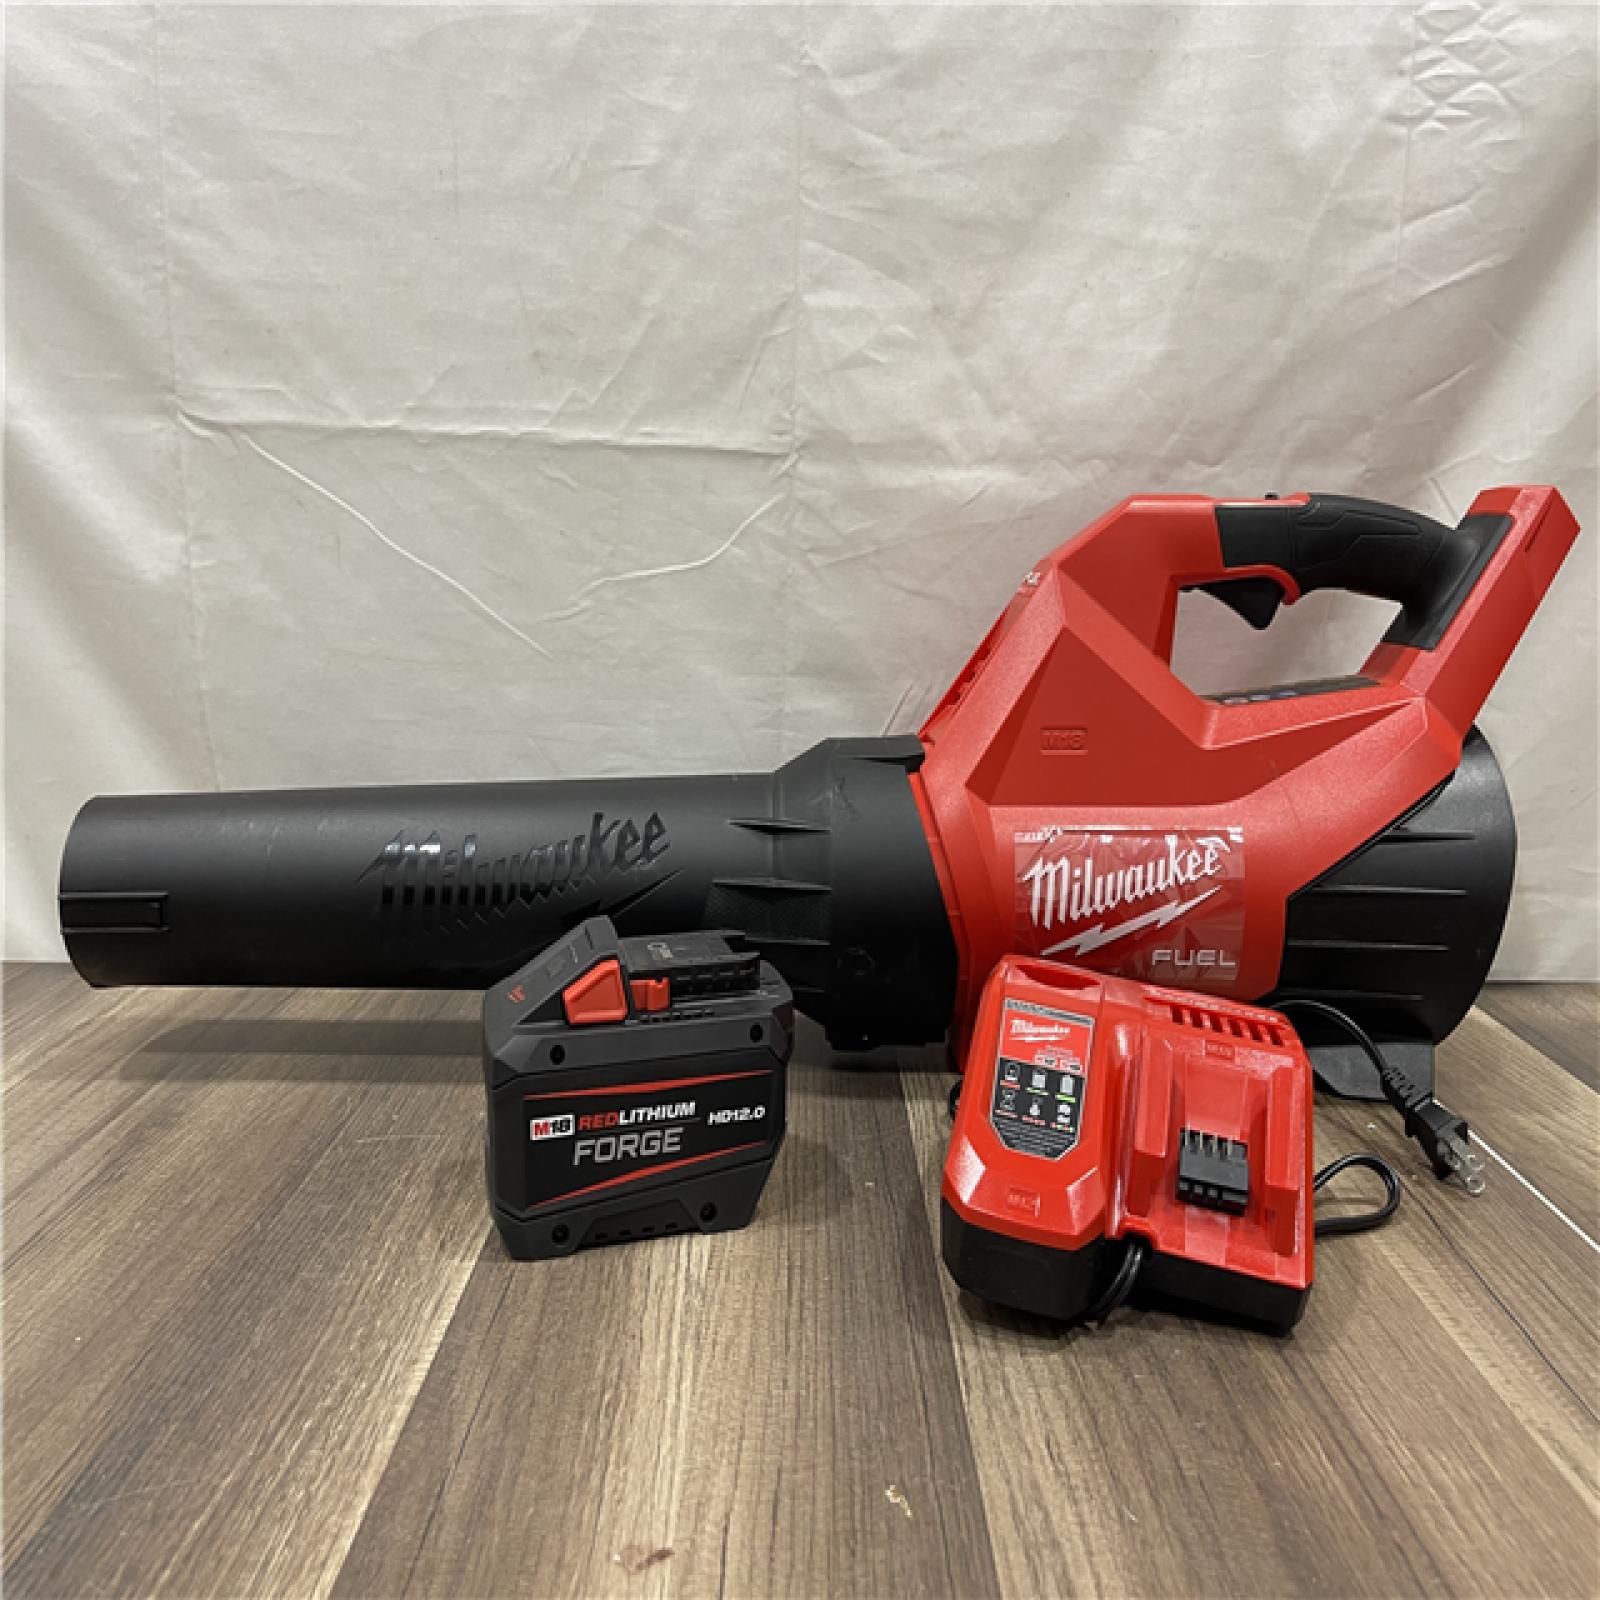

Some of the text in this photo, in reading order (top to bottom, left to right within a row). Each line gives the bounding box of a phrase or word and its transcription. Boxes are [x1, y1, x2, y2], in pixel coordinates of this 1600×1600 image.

[357, 811, 671, 933] Milwaukee
[1021, 835, 1227, 930] Milwaukee
[1152, 949, 1236, 967] FUEL
[578, 1102, 695, 1130] REDLITHIUM
[573, 1127, 683, 1165] FORGE
